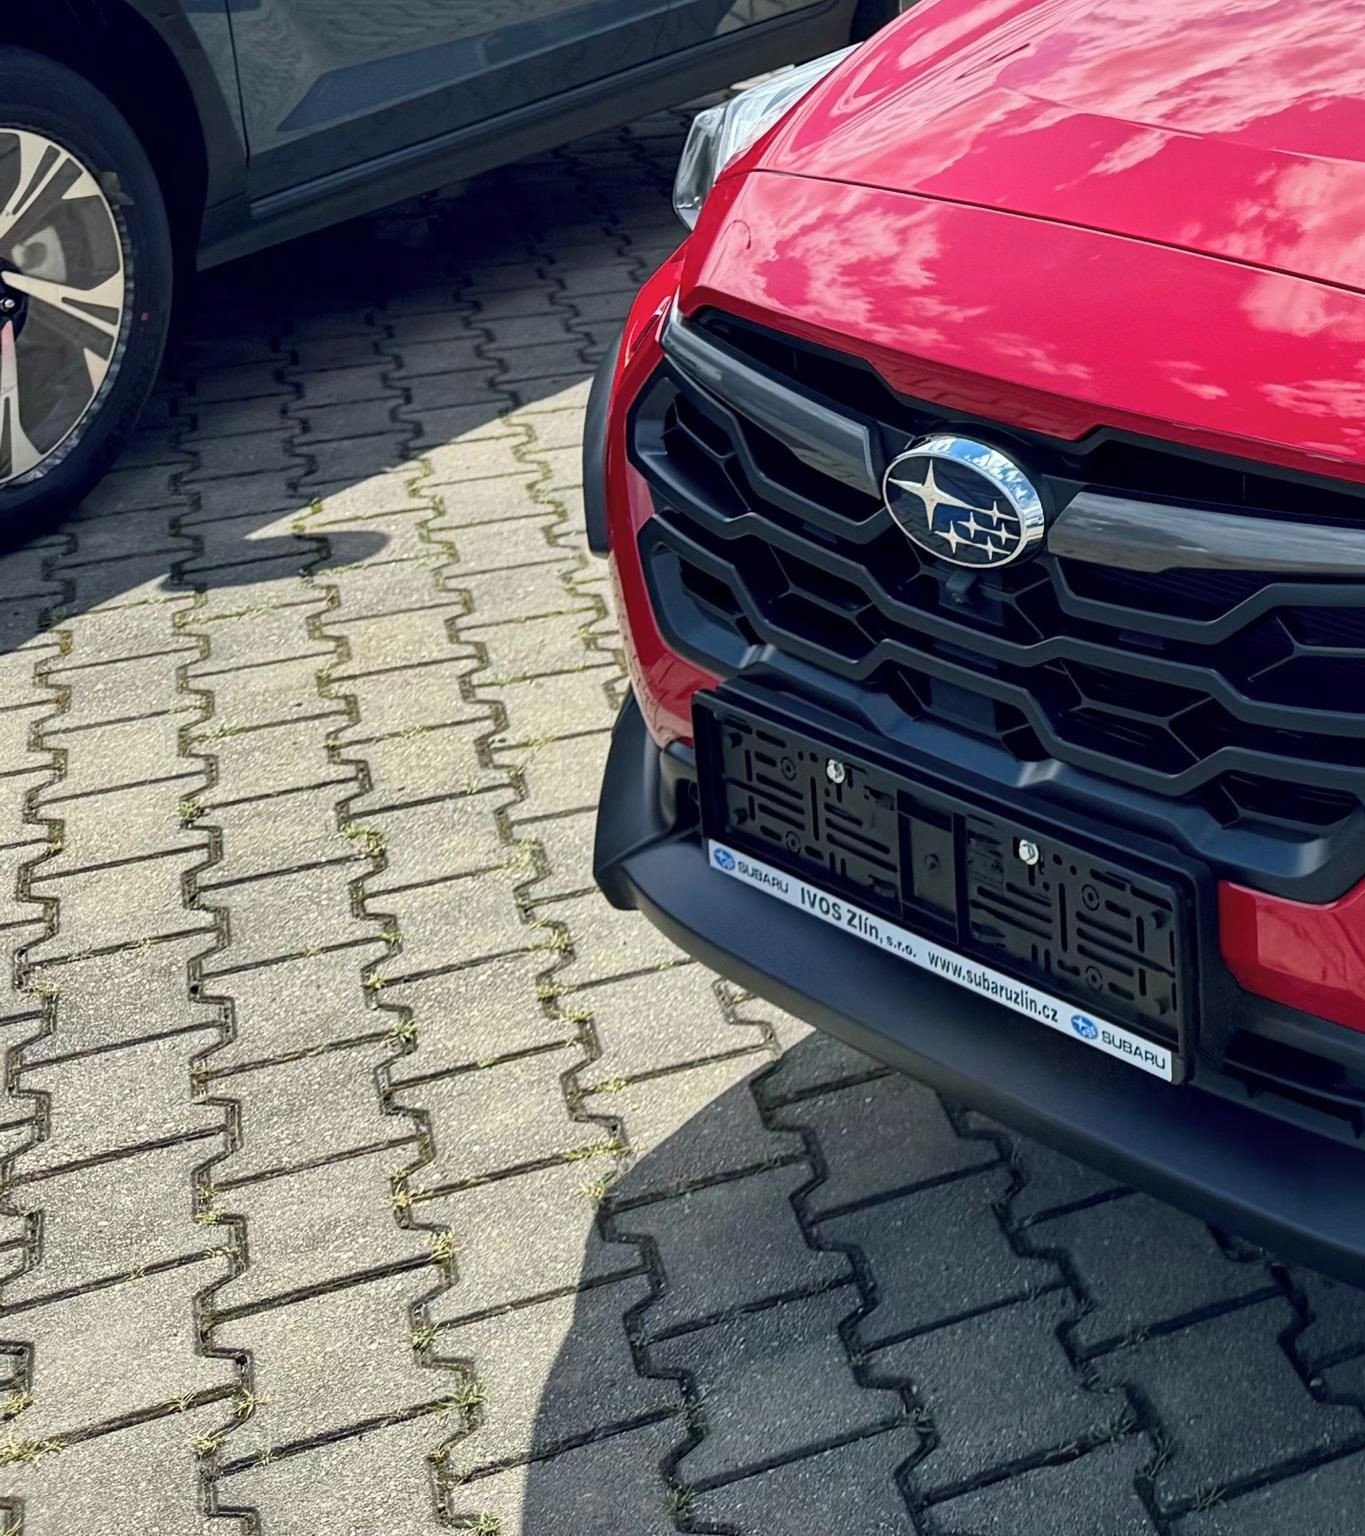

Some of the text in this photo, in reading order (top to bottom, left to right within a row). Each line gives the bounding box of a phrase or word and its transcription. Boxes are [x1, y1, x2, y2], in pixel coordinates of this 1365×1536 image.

[737, 860, 1167, 1071] SUBARU IVOS Zlín, s.r.o. www.subaruzlin.cz SUBARU
